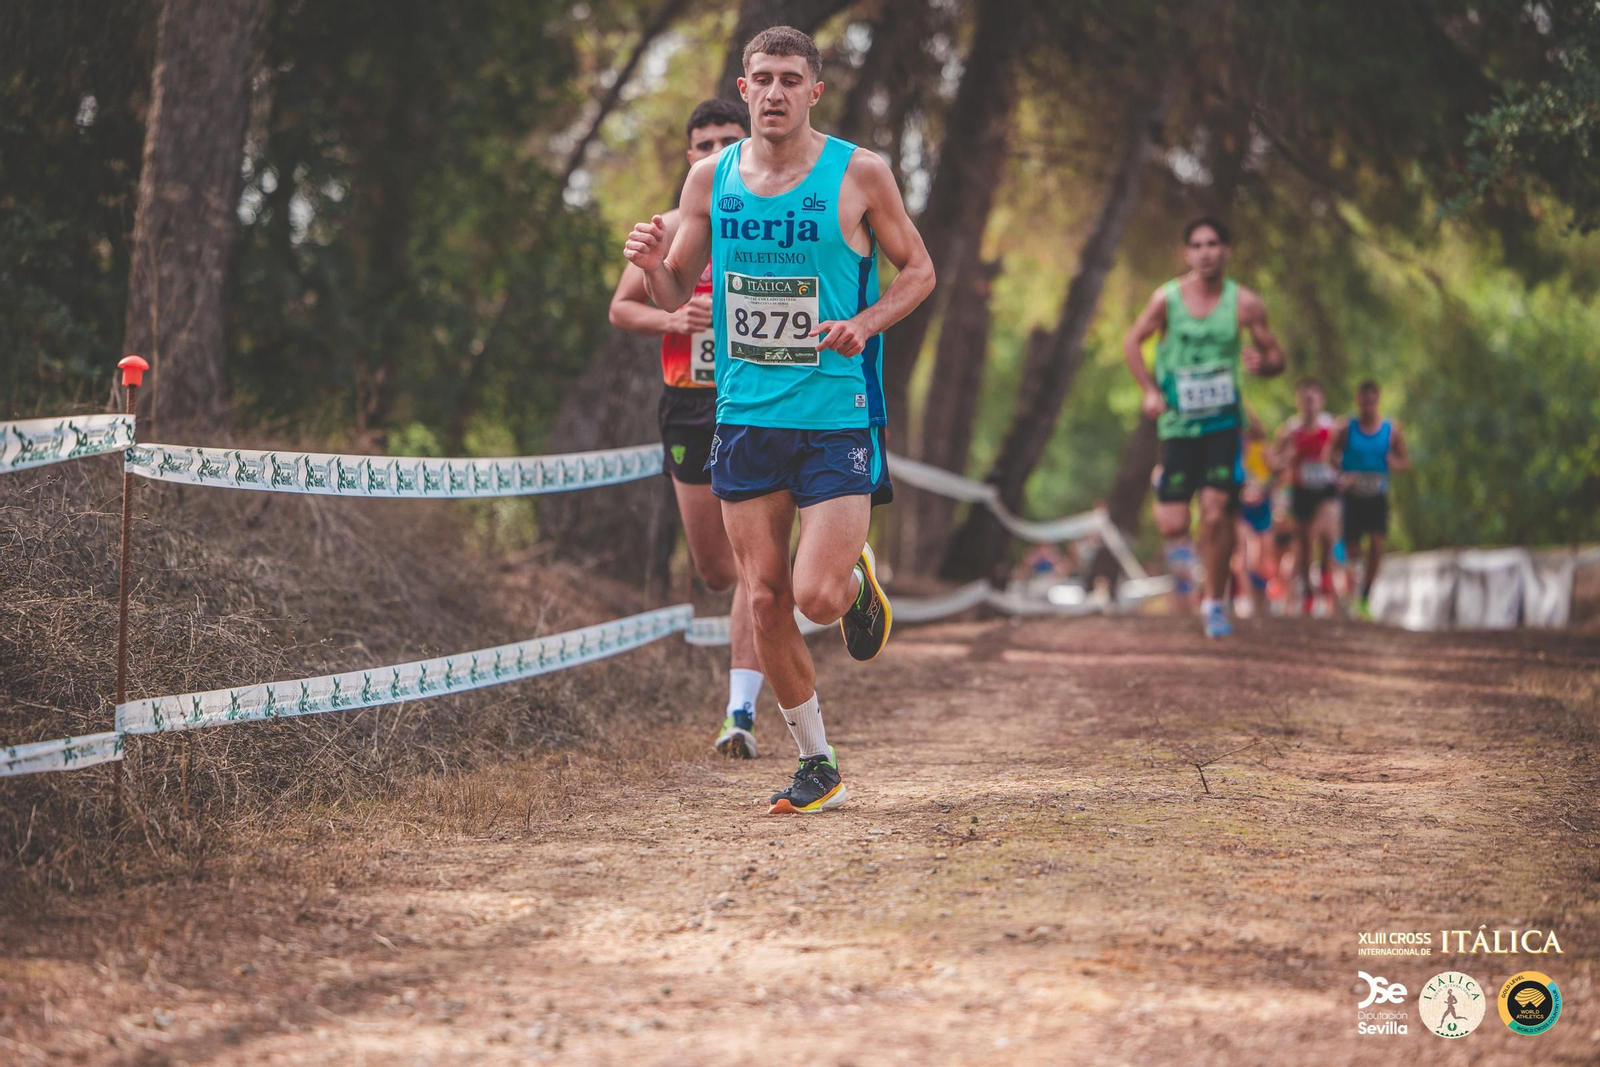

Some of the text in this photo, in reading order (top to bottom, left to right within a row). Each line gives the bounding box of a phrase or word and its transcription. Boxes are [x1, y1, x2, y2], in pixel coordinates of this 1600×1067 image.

[719, 197, 744, 211] TROPS
[720, 211, 820, 249] nerja
[734, 251, 806, 264] ATLETISMO
[747, 279, 792, 293] ITÁLICA
[735, 308, 812, 340] 8279
